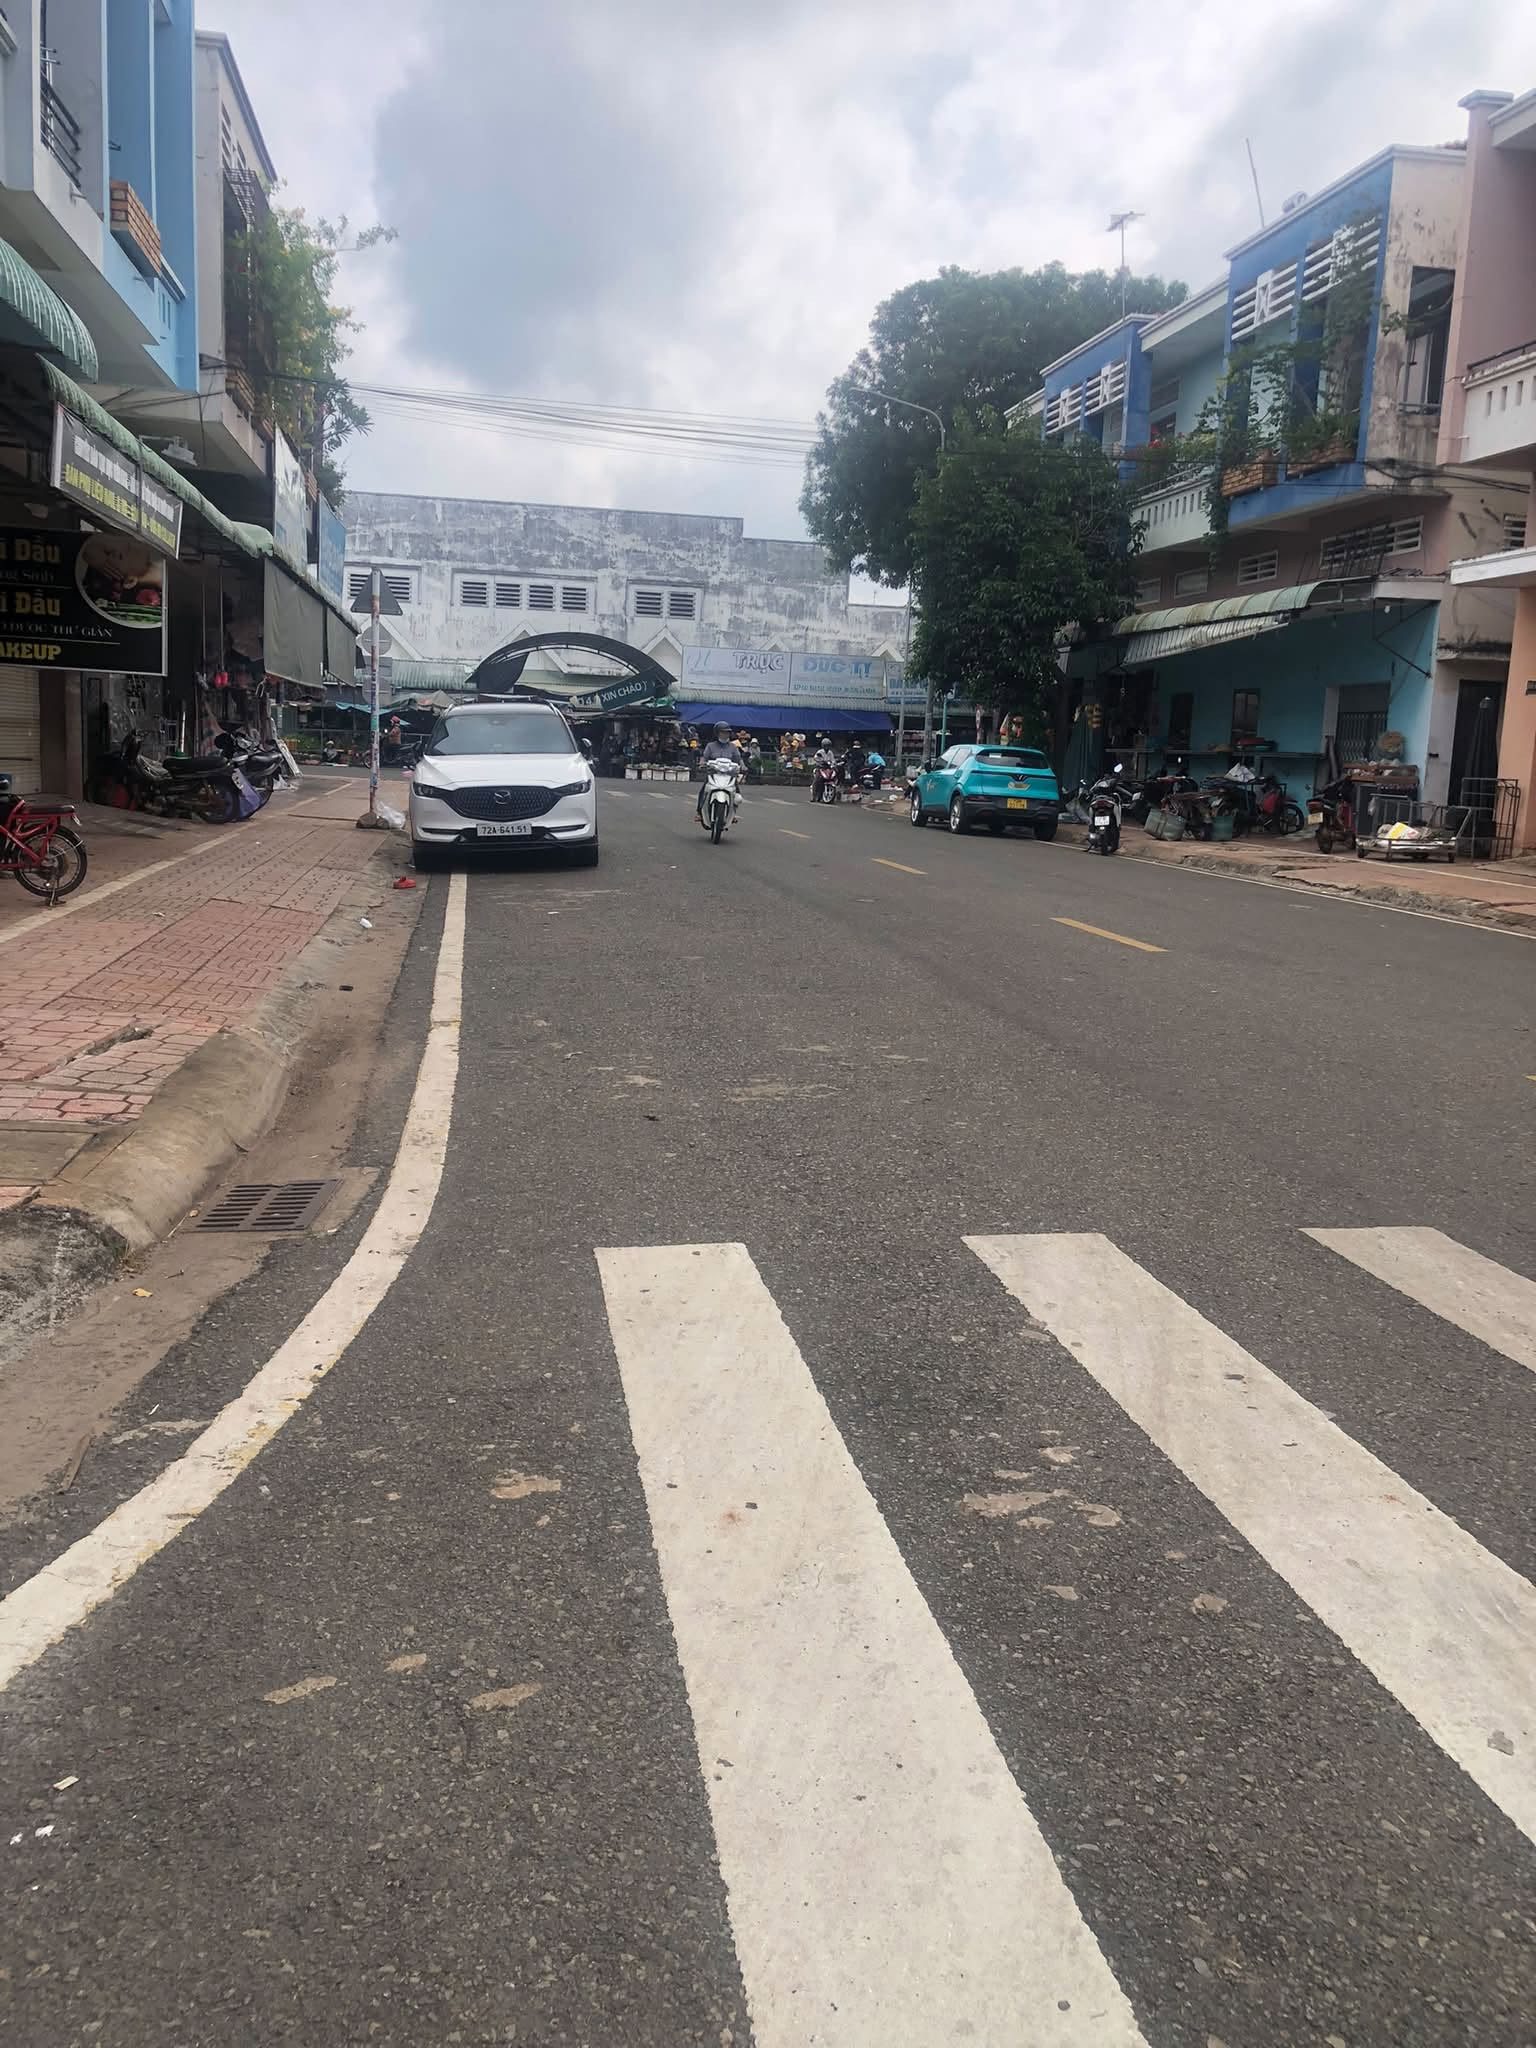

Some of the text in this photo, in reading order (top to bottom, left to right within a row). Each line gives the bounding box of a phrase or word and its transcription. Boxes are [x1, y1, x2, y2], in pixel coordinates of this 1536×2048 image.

[0, 641, 61, 661] AKEUP
[601, 690, 617, 703] XIN
[617, 681, 642, 697] CHÀO
